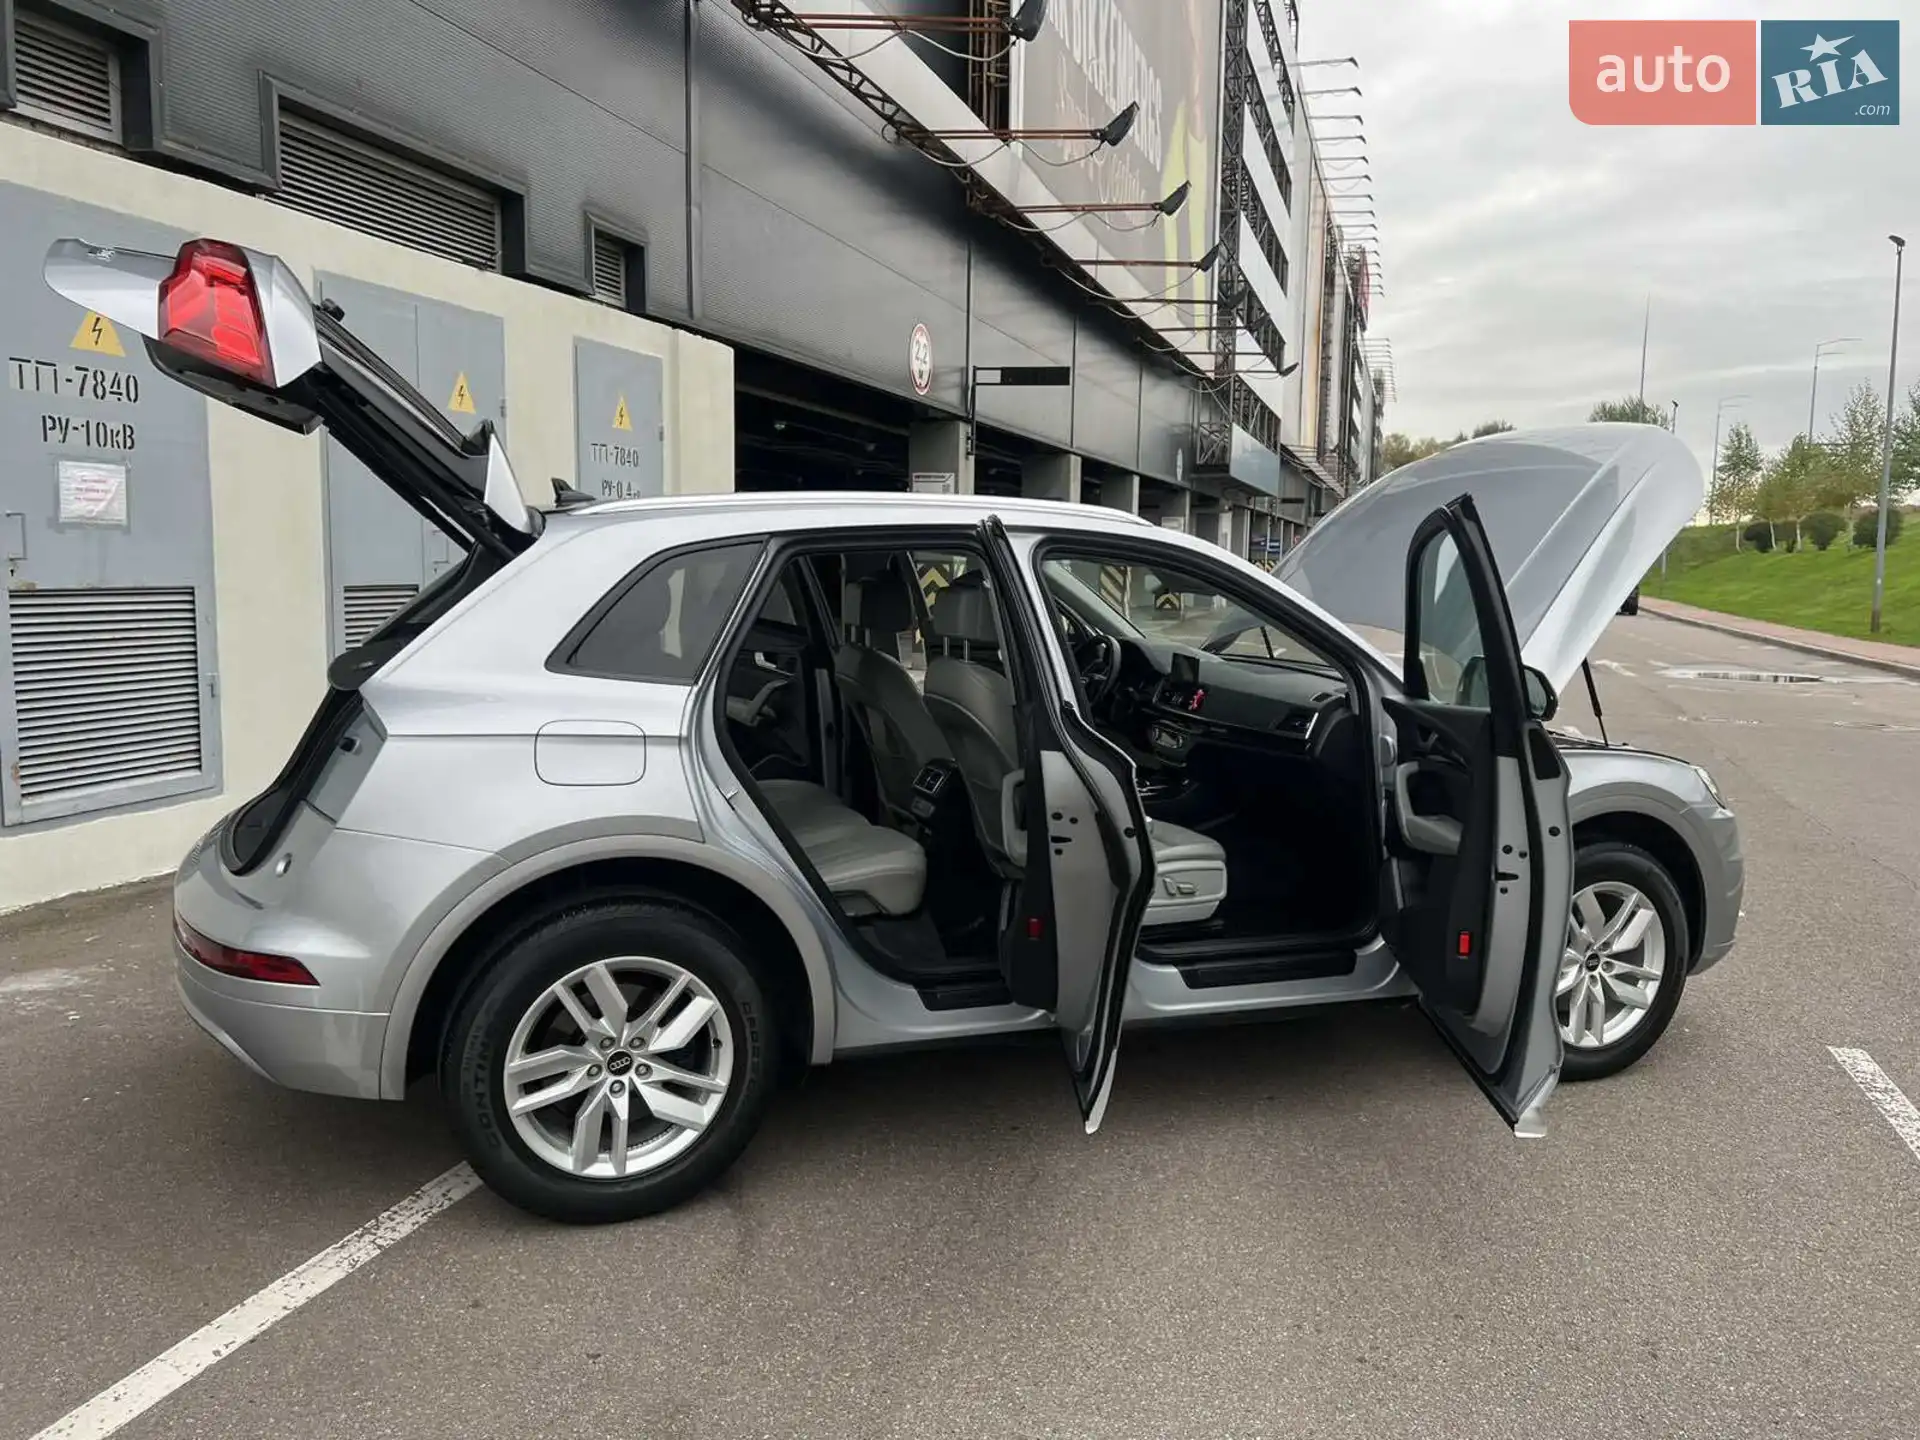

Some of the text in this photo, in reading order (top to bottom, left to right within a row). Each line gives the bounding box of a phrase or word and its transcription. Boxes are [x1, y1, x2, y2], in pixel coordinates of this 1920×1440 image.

[9, 357, 139, 403] ТП-7840
[41, 415, 135, 450] РУ-10кВ
[591, 443, 639, 467] ТП-7840
